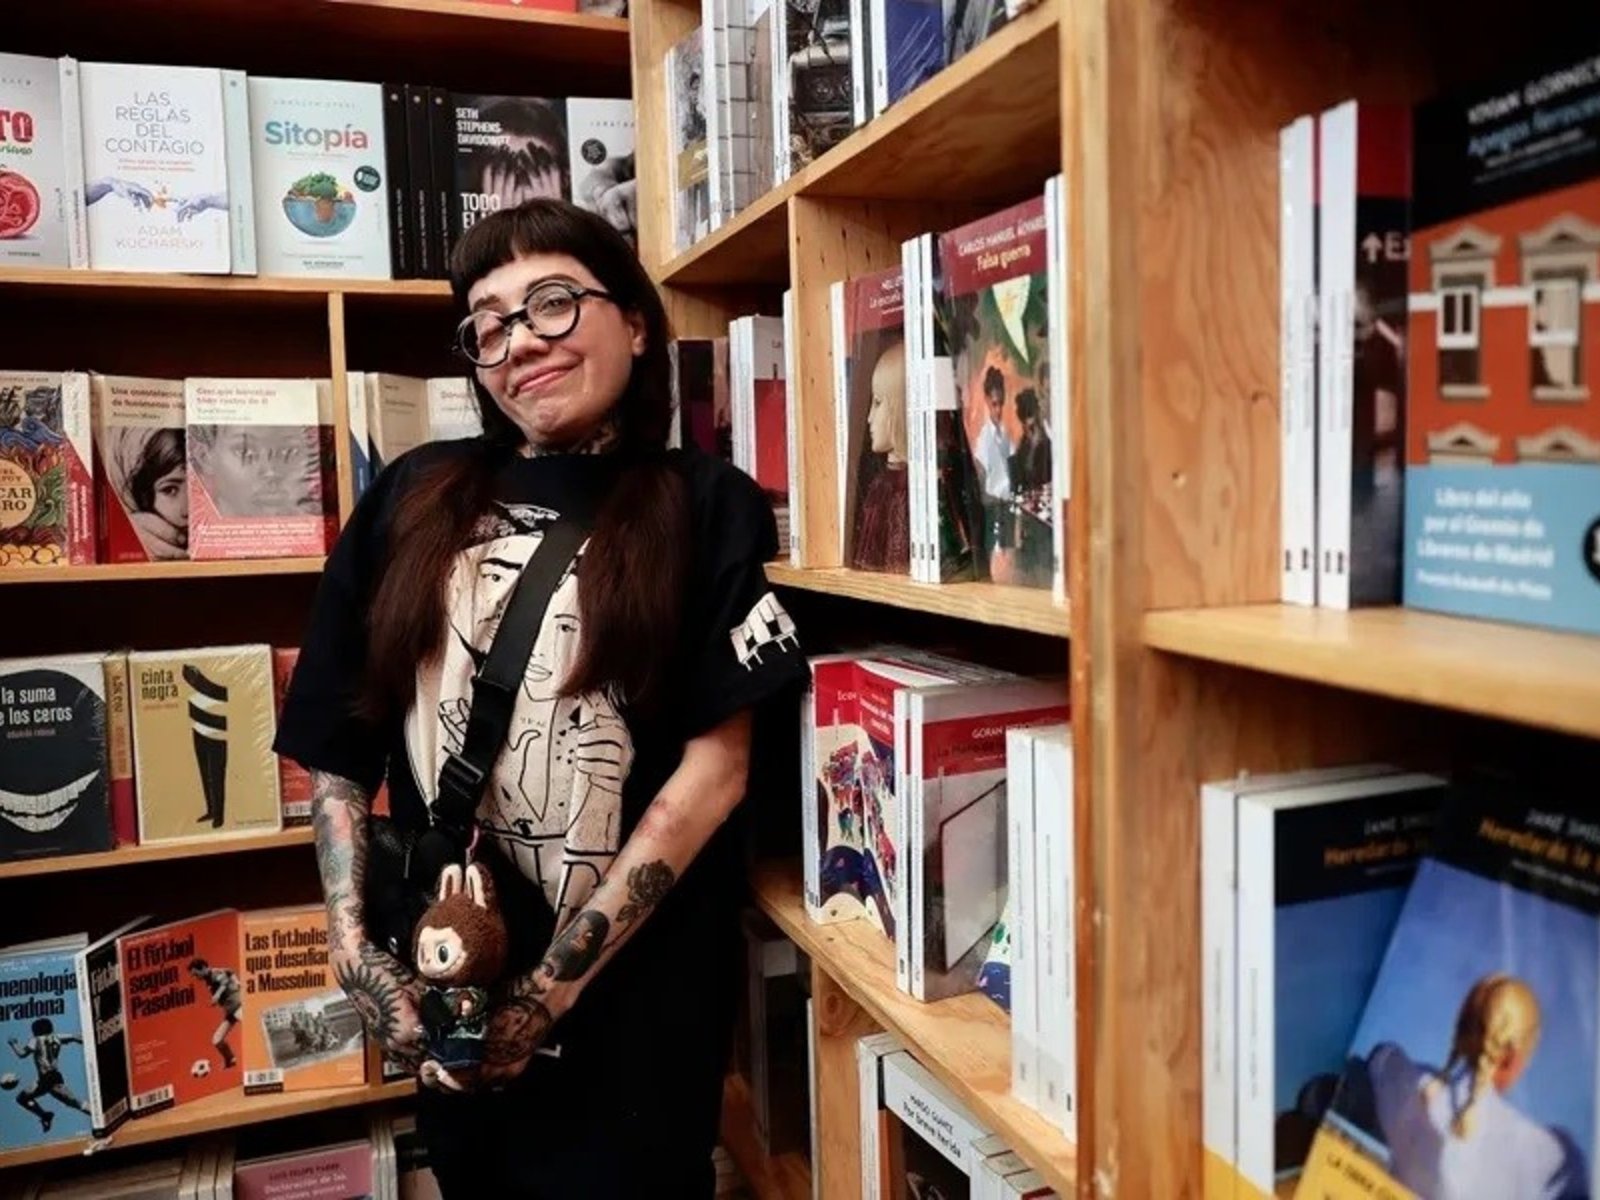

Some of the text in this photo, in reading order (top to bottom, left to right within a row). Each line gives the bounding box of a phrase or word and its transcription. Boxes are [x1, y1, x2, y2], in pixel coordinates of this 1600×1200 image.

[135, 92, 171, 105] LAS
[115, 106, 191, 123] REGLAS
[456, 107, 479, 119] SETH
[136, 124, 172, 139] DEL
[265, 121, 369, 152] Sitopía
[105, 138, 204, 155] CONTAGIO
[461, 193, 501, 211] TODO
[138, 225, 182, 237] ADAM
[115, 237, 203, 250] KUCHARSKI
[977, 244, 1031, 272] Falsa guerra
[112, 387, 128, 395] Una
[3, 500, 27, 511] RO
[141, 668, 174, 685] cinta
[1, 686, 57, 704] la suma
[141, 683, 179, 702] negra
[9, 706, 30, 725] los
[33, 706, 73, 722] ceros
[245, 932, 269, 951] Las
[246, 954, 272, 974] que
[247, 969, 327, 994] a Mussolini
